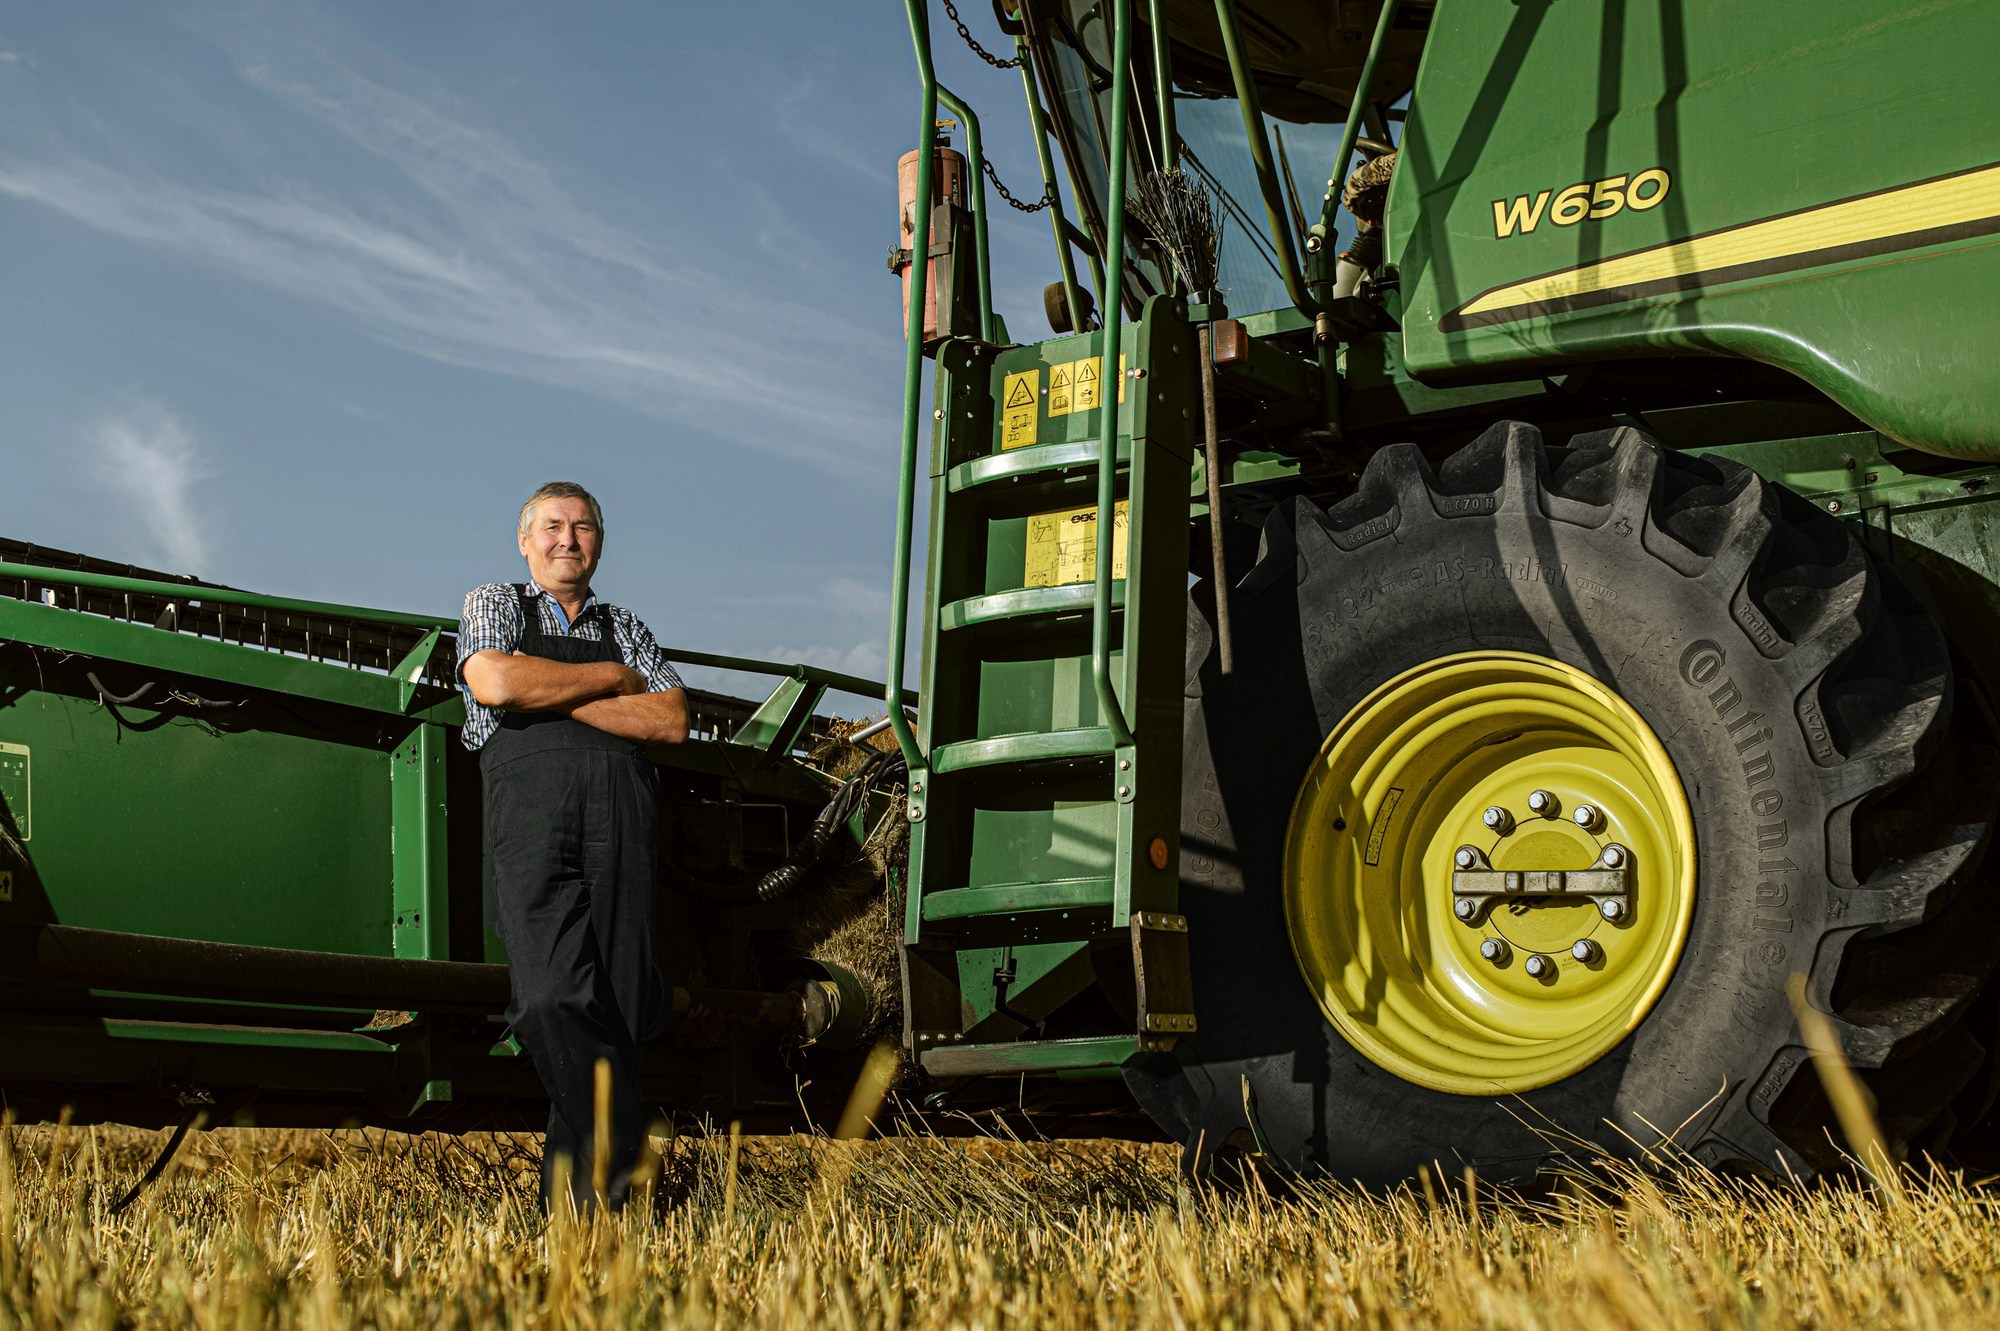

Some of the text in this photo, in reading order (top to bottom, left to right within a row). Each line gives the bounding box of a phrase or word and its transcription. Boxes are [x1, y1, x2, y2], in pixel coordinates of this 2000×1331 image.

[1491, 166, 1672, 240] W650
[1444, 497, 1494, 513] AC70 H
[1347, 518, 1391, 546] Radial
[1434, 555, 1568, 588] AS-Radial
[1737, 603, 1778, 650] Radial
[1801, 701, 1832, 759] AC70 H
[1678, 638, 1799, 933] Continental
[1756, 1055, 1796, 1106] Radial
